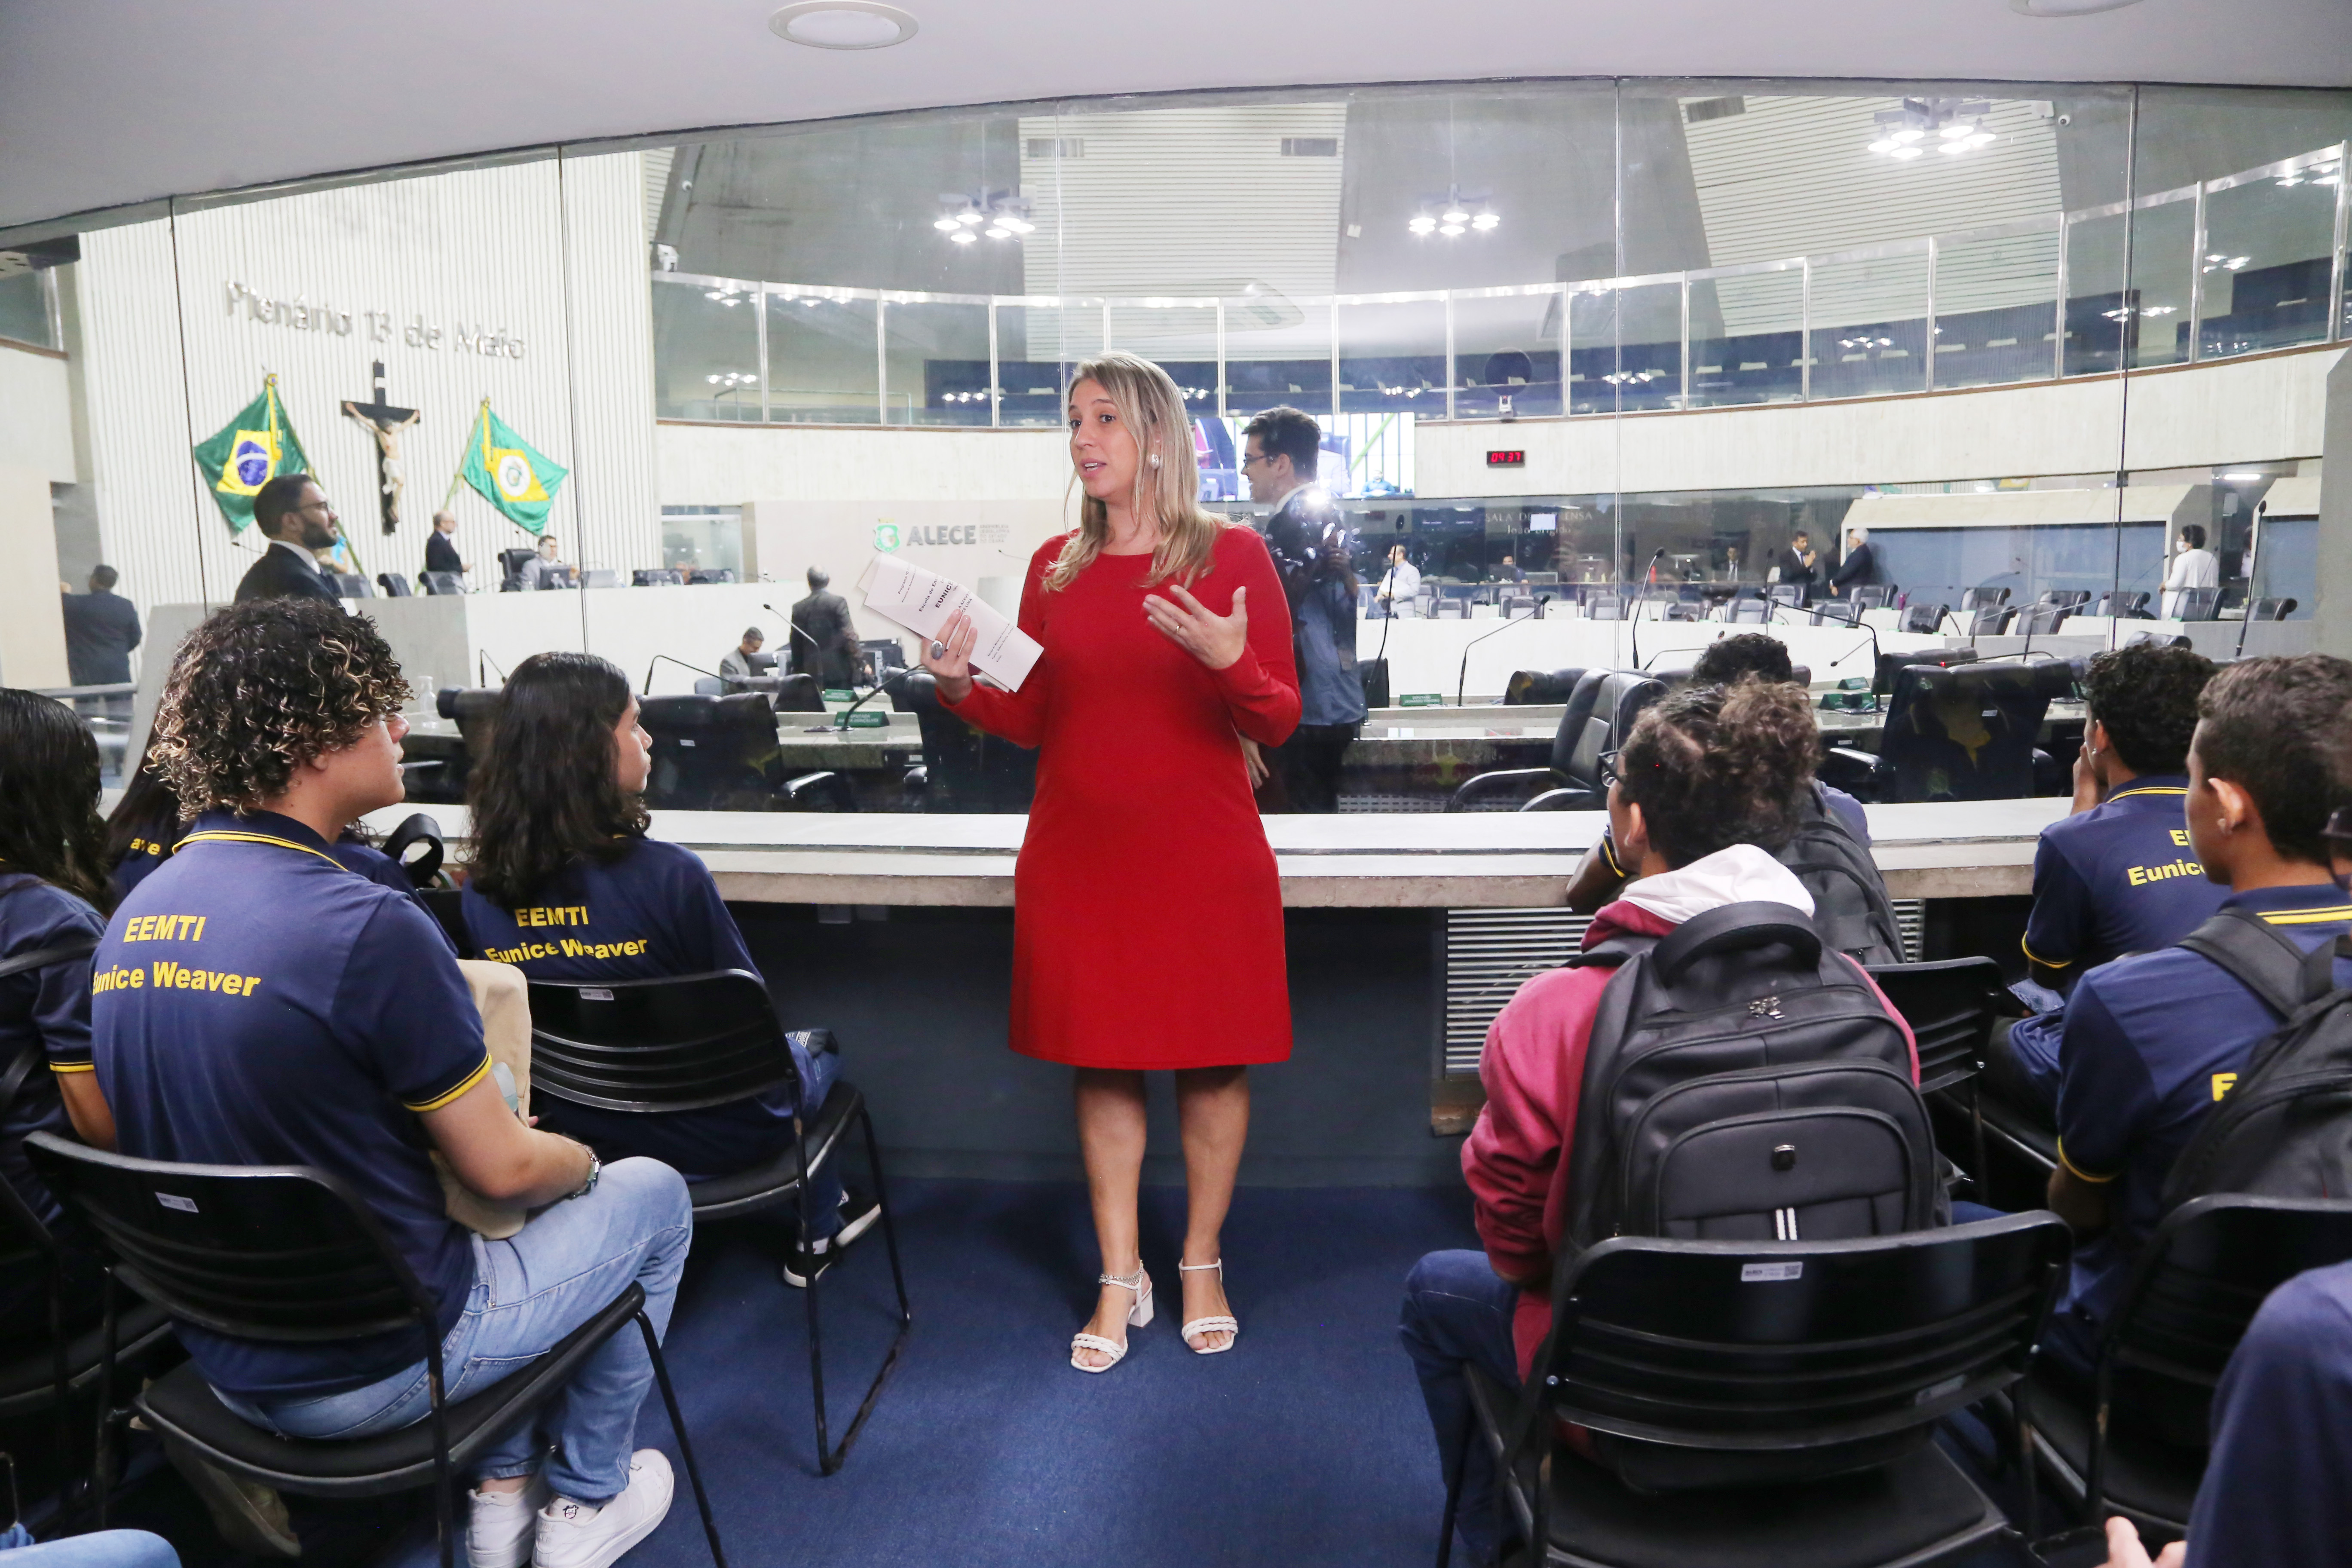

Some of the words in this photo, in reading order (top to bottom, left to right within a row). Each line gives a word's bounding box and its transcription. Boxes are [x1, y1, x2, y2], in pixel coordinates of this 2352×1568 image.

[225, 279, 353, 337] Plenário
[364, 309, 392, 343] 13
[404, 313, 441, 349] de
[454, 321, 526, 359] Maio
[1485, 512, 1513, 522] SALA
[907, 525, 976, 545] ALECE
[898, 576, 907, 594] Programa
[935, 579, 954, 608] EUNICE
[919, 595, 930, 612] Escola
[123, 914, 206, 942] EEMTI
[514, 906, 589, 927] EEMTI
[484, 942, 560, 964] Eunice
[560, 939, 648, 959] Weaver
[153, 961, 261, 997] Weaver
